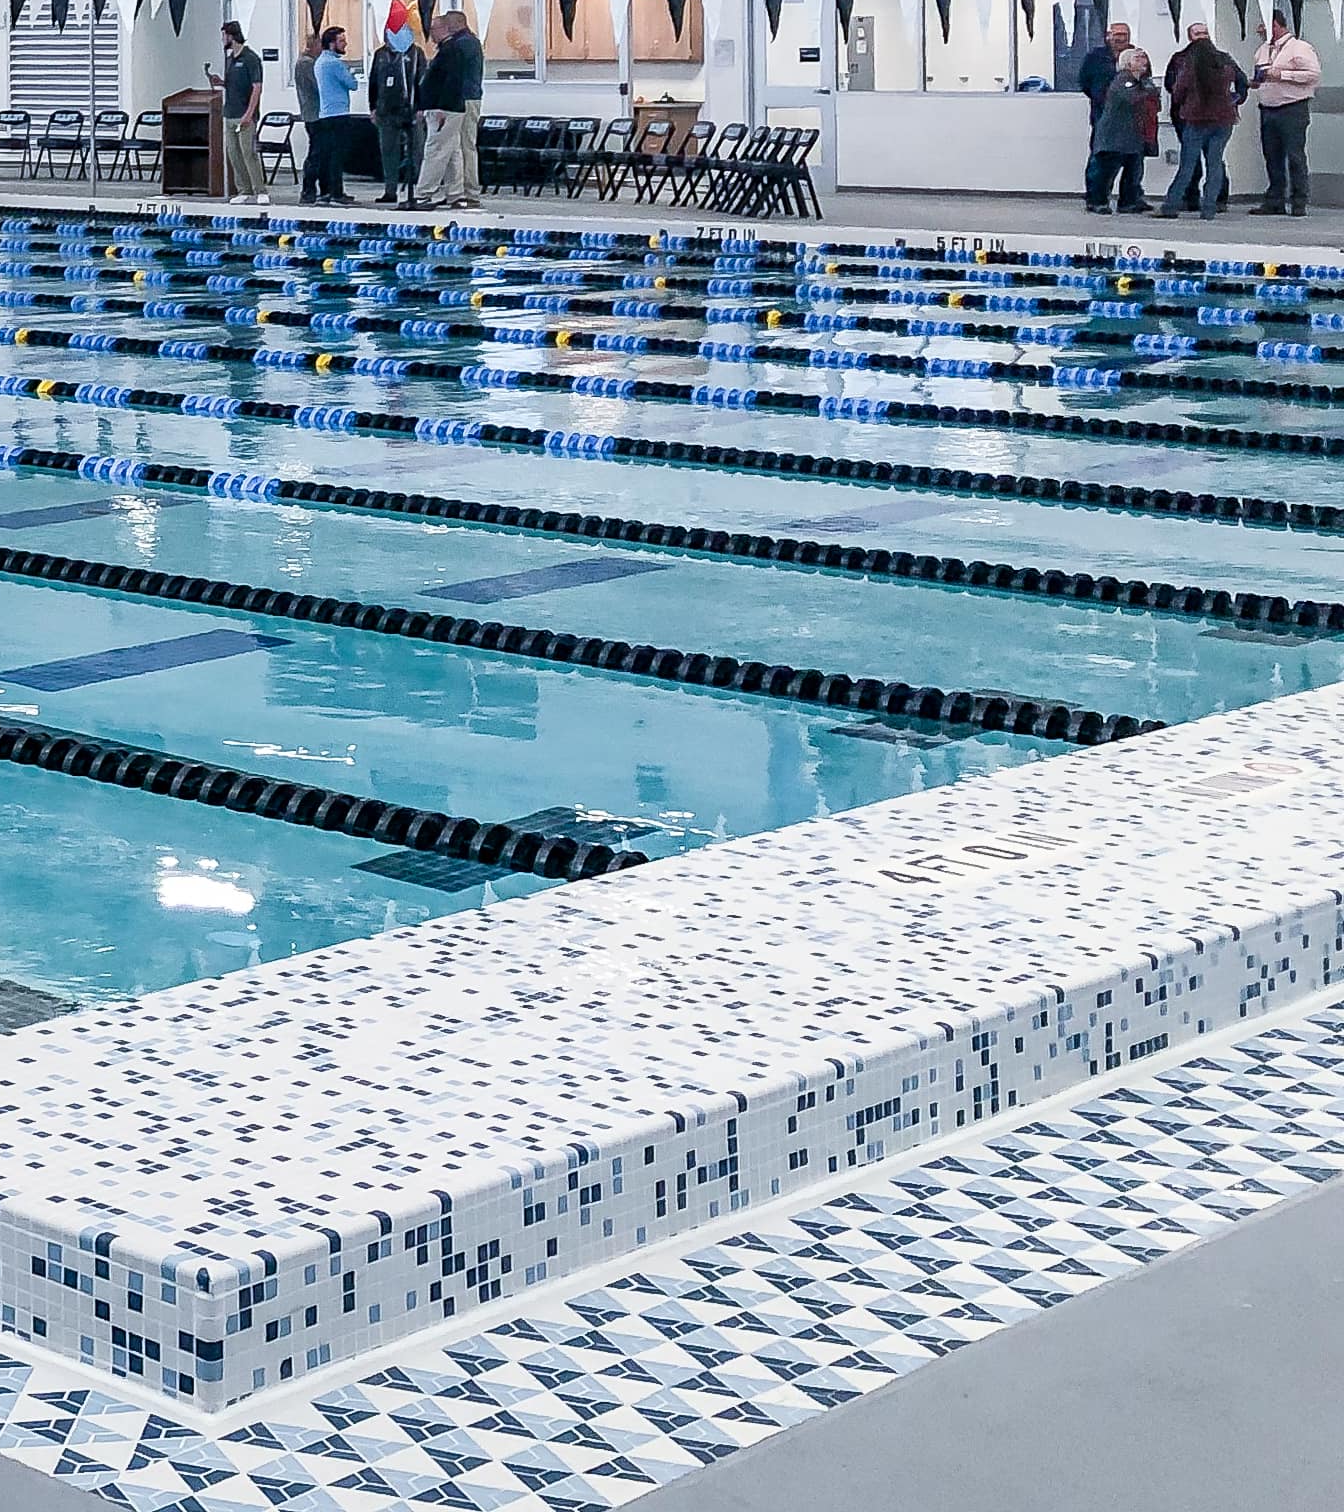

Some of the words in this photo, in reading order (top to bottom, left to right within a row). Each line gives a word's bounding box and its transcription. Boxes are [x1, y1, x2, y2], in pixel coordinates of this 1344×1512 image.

[952, 237, 968, 250] FT
[990, 238, 1005, 252] IN
[995, 830, 1079, 851] IN
[905, 854, 991, 877] FT
[878, 869, 941, 884] 4
